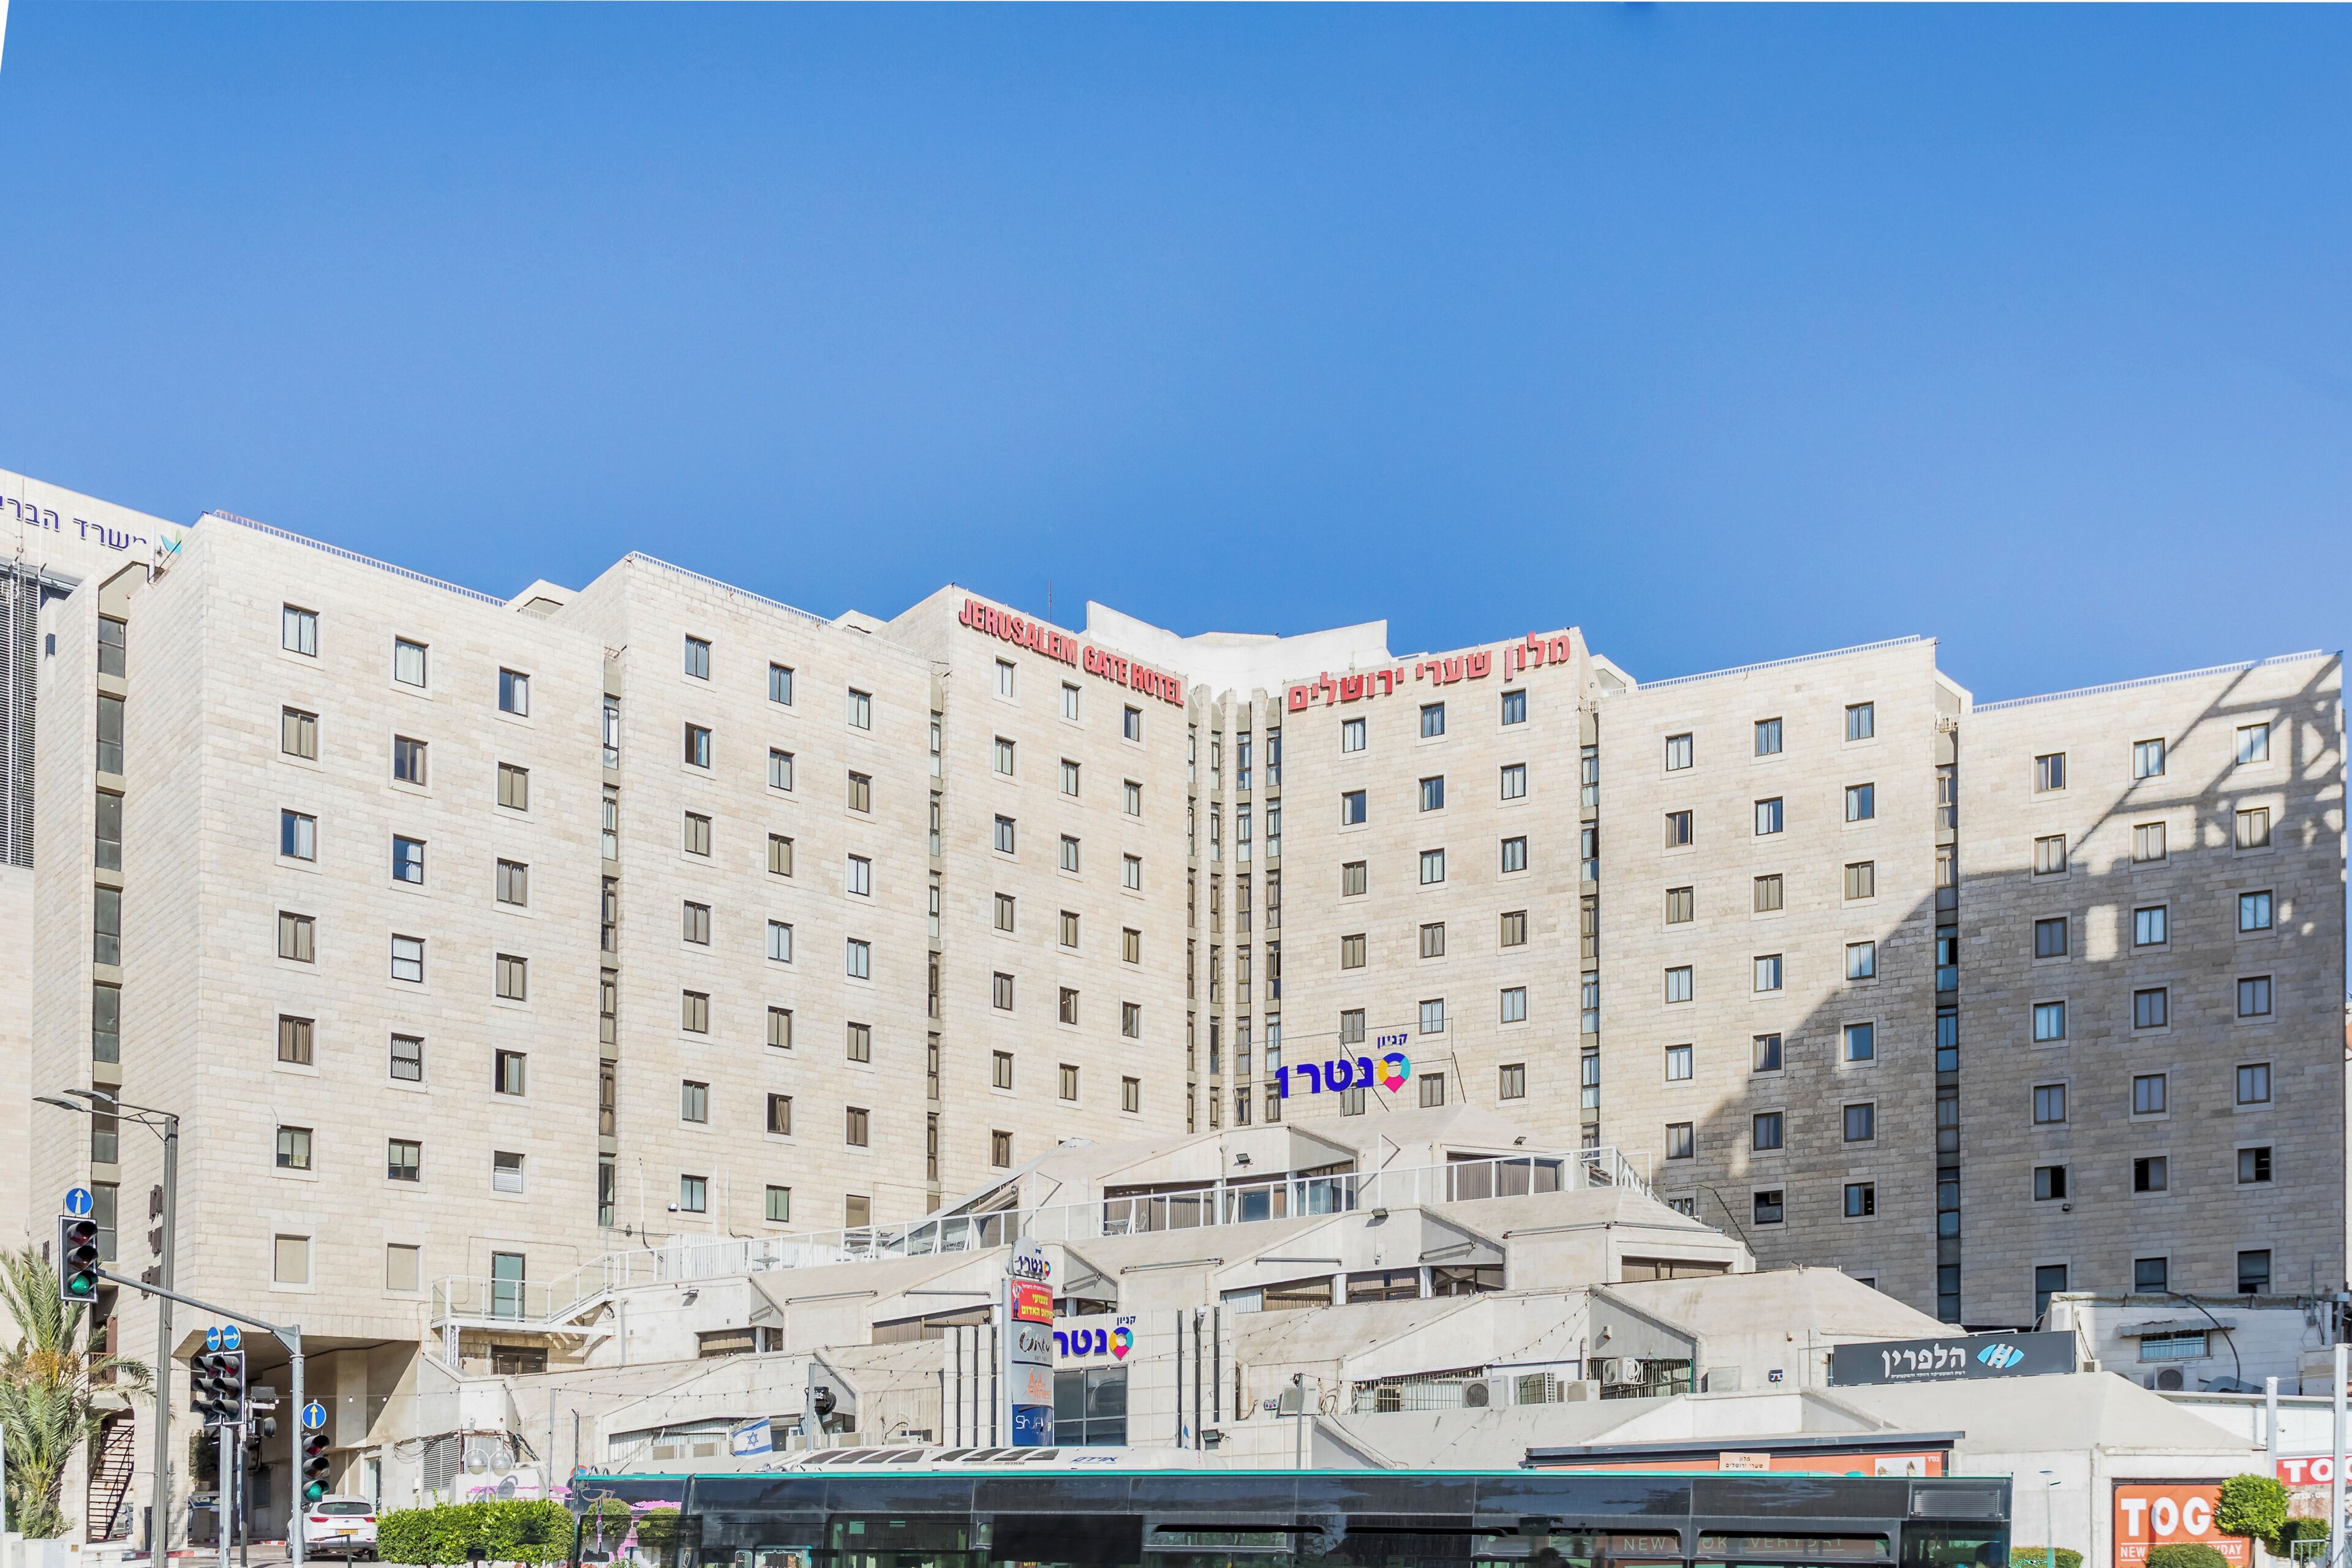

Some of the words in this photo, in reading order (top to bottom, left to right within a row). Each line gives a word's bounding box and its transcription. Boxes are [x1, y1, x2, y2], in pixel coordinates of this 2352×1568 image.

[959, 598, 1078, 667] JERUSALEM
[1083, 645, 1128, 686] GATE
[1131, 662, 1185, 707] HOTEL
[1415, 649, 1491, 685] שערי
[1505, 631, 1570, 680] מלון
[1288, 666, 1404, 712] ירושלים
[1377, 1033, 1408, 1049] קניון
[1021, 1305, 1040, 1316] האדום
[1117, 1316, 1136, 1325] קניון
[1881, 1343, 1966, 1378] הלפרין
[2283, 1458, 2352, 1483] TO
[2120, 1496, 2211, 1536] TOG
[1624, 1537, 1665, 1551] NEW
[2120, 1547, 2146, 1558] NEW
